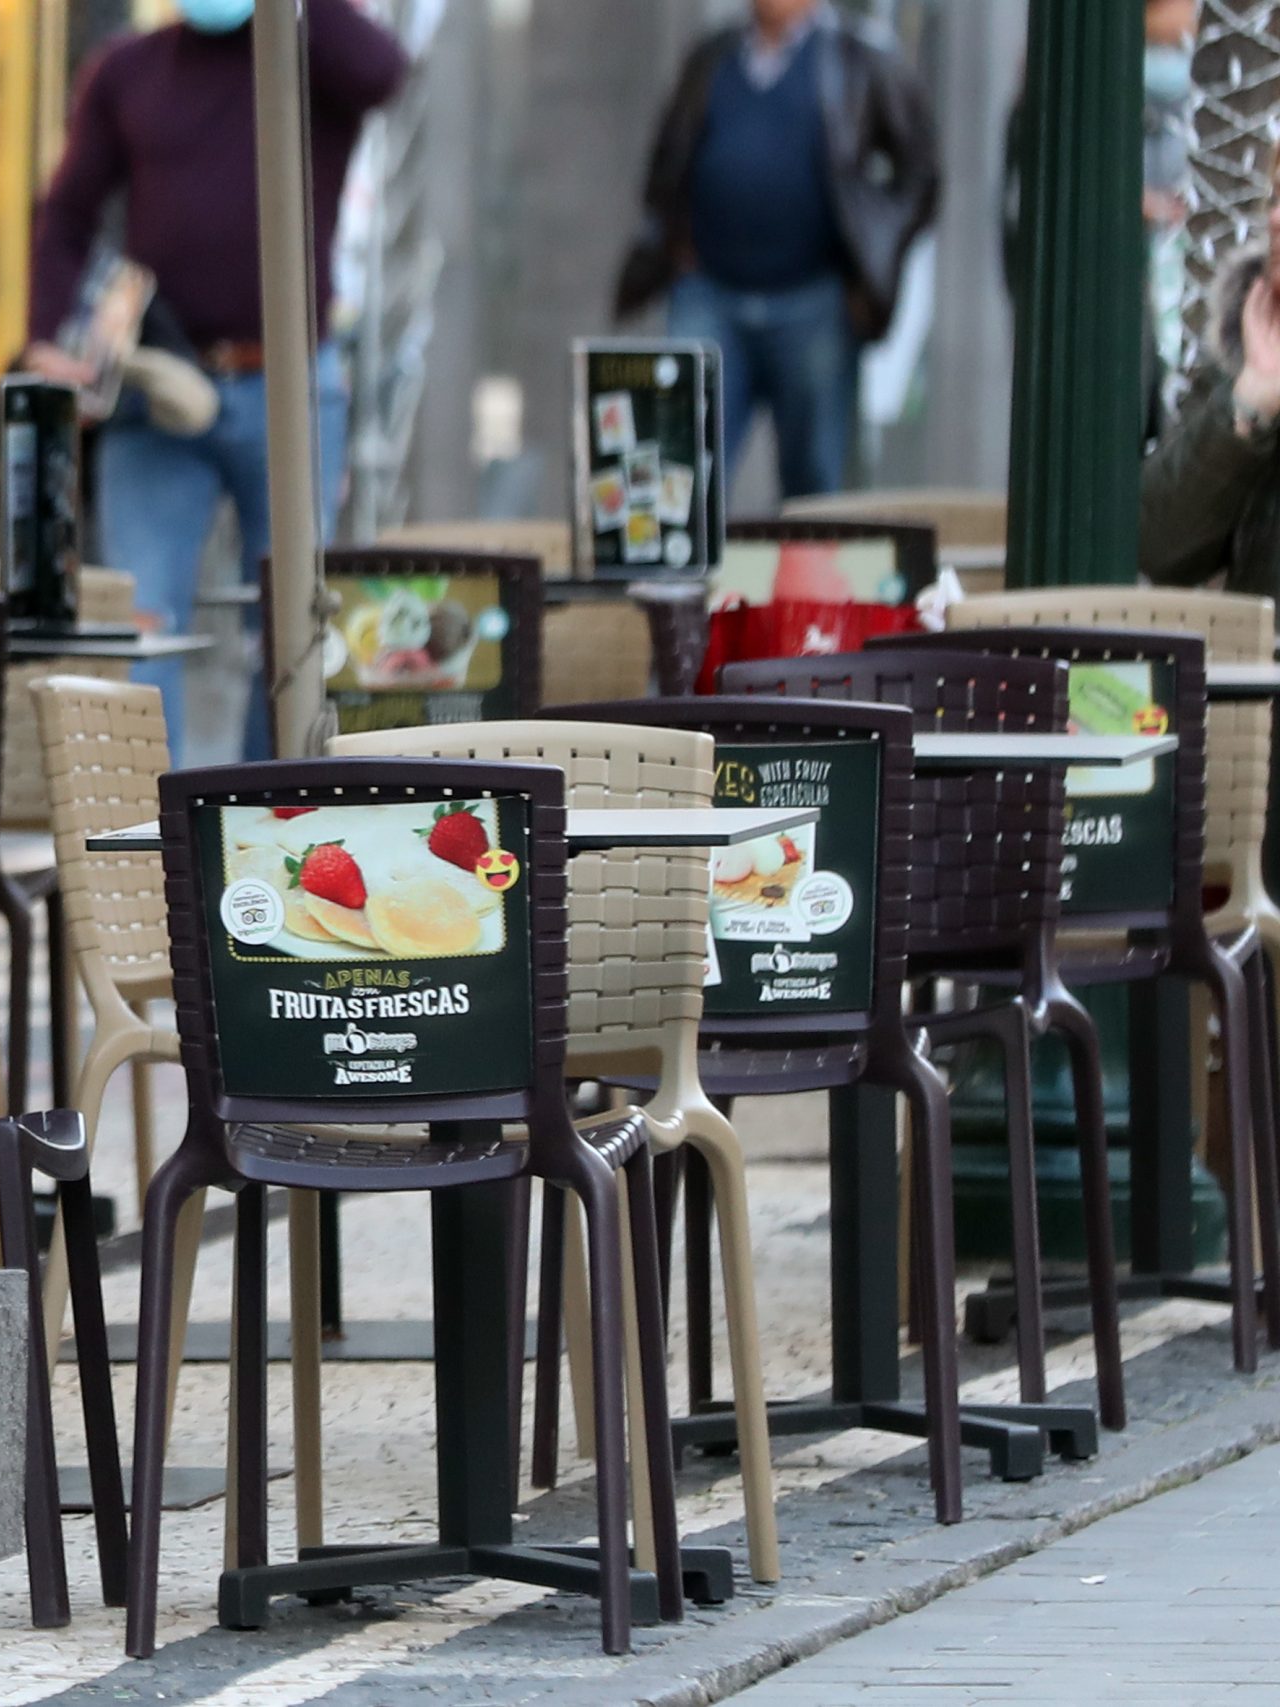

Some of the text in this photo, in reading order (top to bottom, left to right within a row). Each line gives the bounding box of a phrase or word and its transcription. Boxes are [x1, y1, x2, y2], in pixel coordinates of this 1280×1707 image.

[758, 759, 832, 784] WITH FRUIT
[324, 968, 412, 990] APENAS
[268, 983, 471, 1020] FRUTAS FRESCAS
